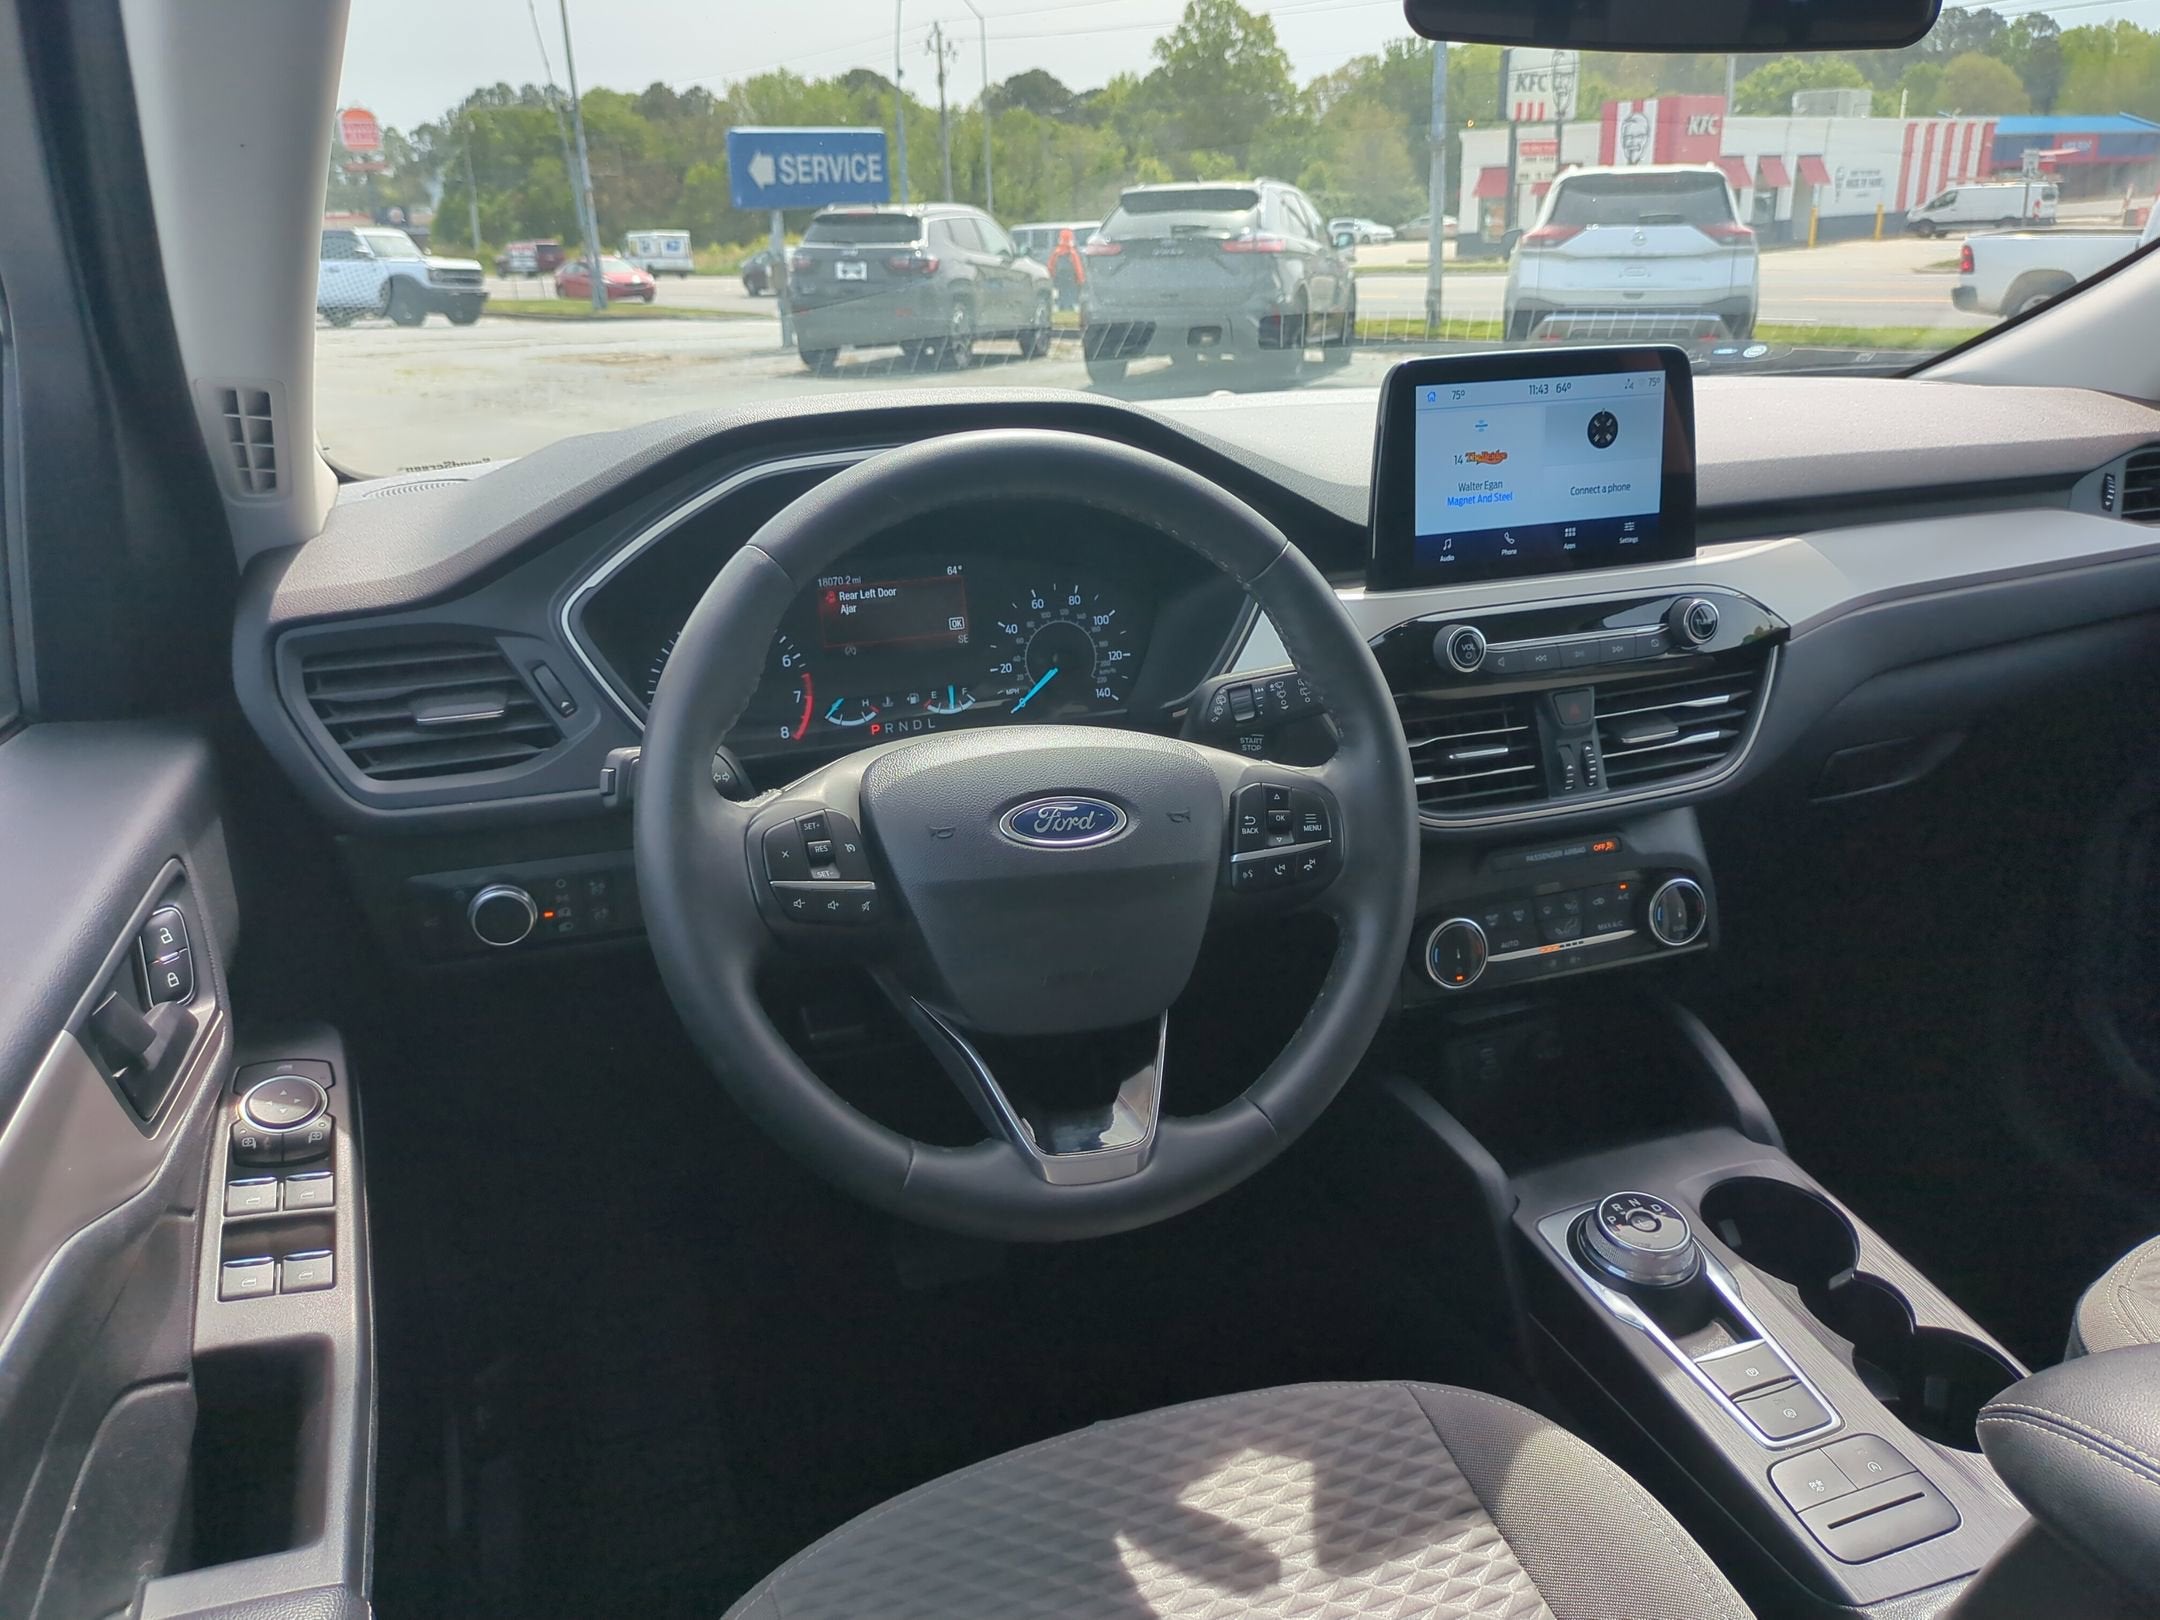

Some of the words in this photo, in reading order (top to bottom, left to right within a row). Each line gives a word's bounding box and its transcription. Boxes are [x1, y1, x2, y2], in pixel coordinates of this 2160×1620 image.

[1515, 73, 1550, 93] KFC
[1687, 114, 1720, 136] KFC
[779, 153, 884, 185] SERVICE
[1528, 384, 1550, 395] 11:43
[1454, 454, 1463, 465] 14
[1458, 481, 1483, 492] Walter
[1484, 480, 1503, 491] Egan
[1570, 484, 1600, 496] Connect
[1601, 486, 1607, 494] a
[1607, 482, 1631, 494] phone
[1447, 495, 1476, 507] Magnet
[1477, 493, 1493, 503] And
[1493, 491, 1513, 502] Steel
[1619, 535, 1639, 545] Settings
[1563, 542, 1576, 550] Apps
[1501, 548, 1518, 556] Phone
[1439, 555, 1455, 563] Audio
[852, 576, 862, 584] mi
[838, 591, 858, 602] Rear
[859, 588, 876, 600] Left
[877, 587, 897, 597] Door
[1031, 598, 1045, 609] 60
[1068, 595, 1081, 605] 80
[840, 604, 857, 615] Ajar
[951, 619, 963, 629] OK
[1093, 615, 1110, 625] 100
[1005, 624, 1018, 634] 40
[957, 634, 969, 644] SE
[1461, 643, 1476, 651] VOL
[1108, 650, 1123, 661] 120
[782, 655, 792, 668] 6
[1000, 663, 1013, 674] 20
[931, 691, 937, 699] E
[961, 687, 967, 695] F
[1095, 687, 1111, 698] 140
[793, 690, 802, 704] 7
[862, 699, 869, 707] H
[871, 724, 881, 735] P
[884, 723, 894, 733] R
[898, 721, 908, 732] N
[913, 719, 923, 730] D
[928, 718, 936, 729] L
[780, 726, 790, 739] 8
[1033, 805, 1096, 833] Ford
[1241, 827, 1259, 835] BACK
[1303, 824, 1322, 832] MENU
[814, 844, 828, 853] RES
[1593, 843, 1606, 852] OFF
[1501, 939, 1519, 949] AUTO
[1628, 1198, 1641, 1207] N
[1650, 1203, 1662, 1212] D
[1607, 1216, 1616, 1224] P
